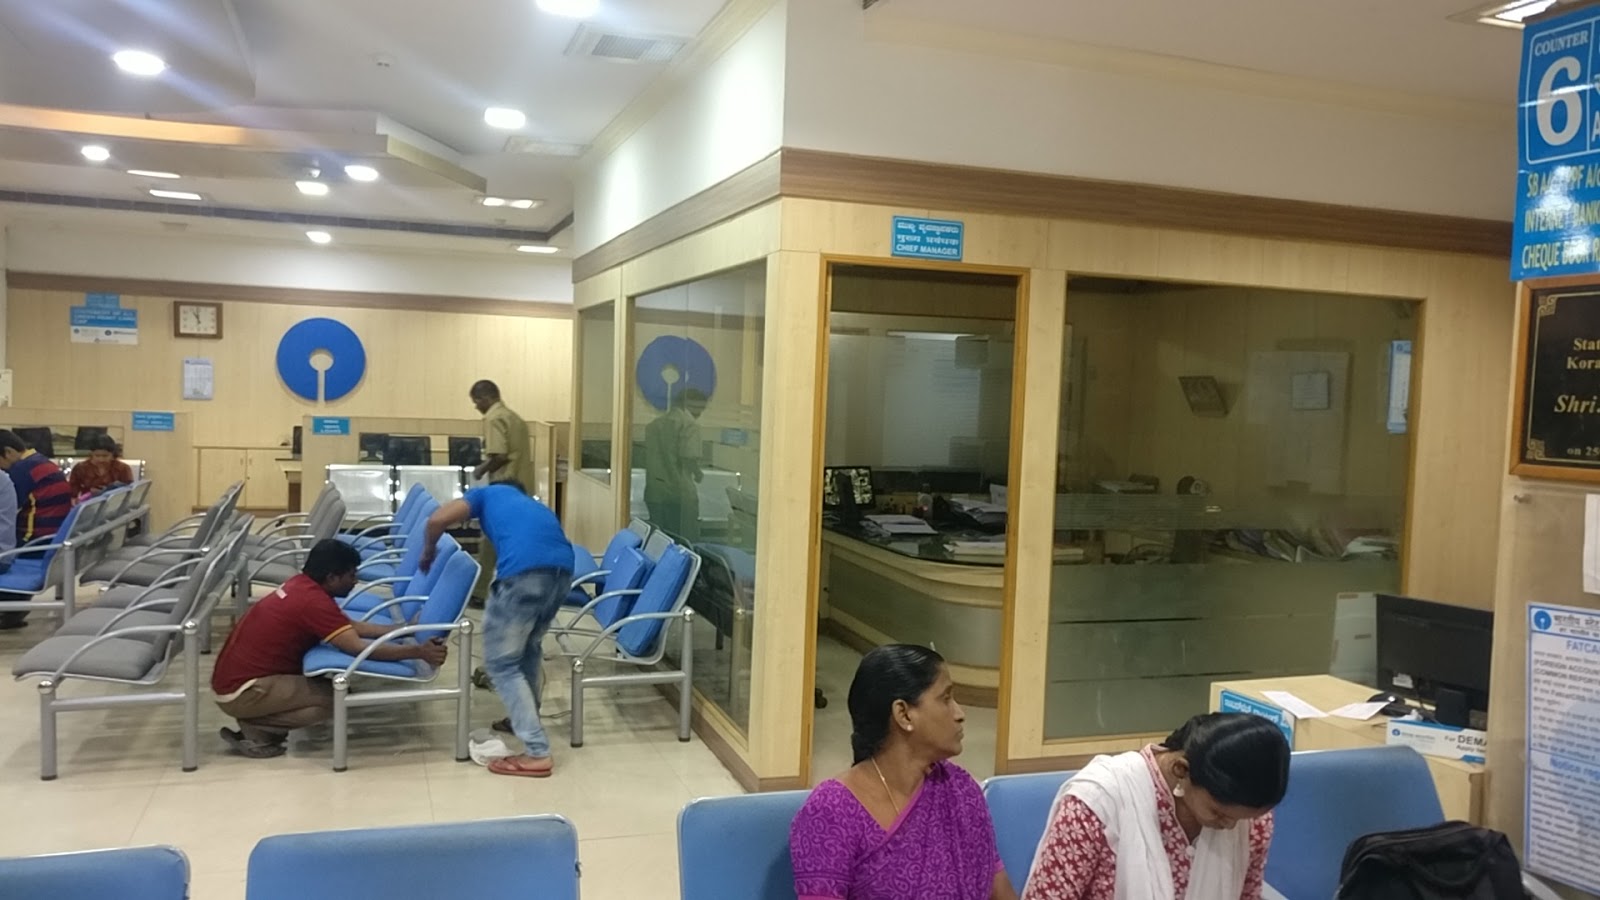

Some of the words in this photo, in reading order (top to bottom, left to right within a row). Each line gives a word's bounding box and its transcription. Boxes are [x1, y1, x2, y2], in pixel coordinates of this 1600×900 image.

[1535, 31, 1588, 56] COUNTER
[1536, 56, 1582, 146] 6
[896, 244, 919, 252] CHIEF
[920, 245, 958, 255] MANAGER
[1522, 242, 1560, 271] CHEQUE
[1567, 448, 1581, 456] on
